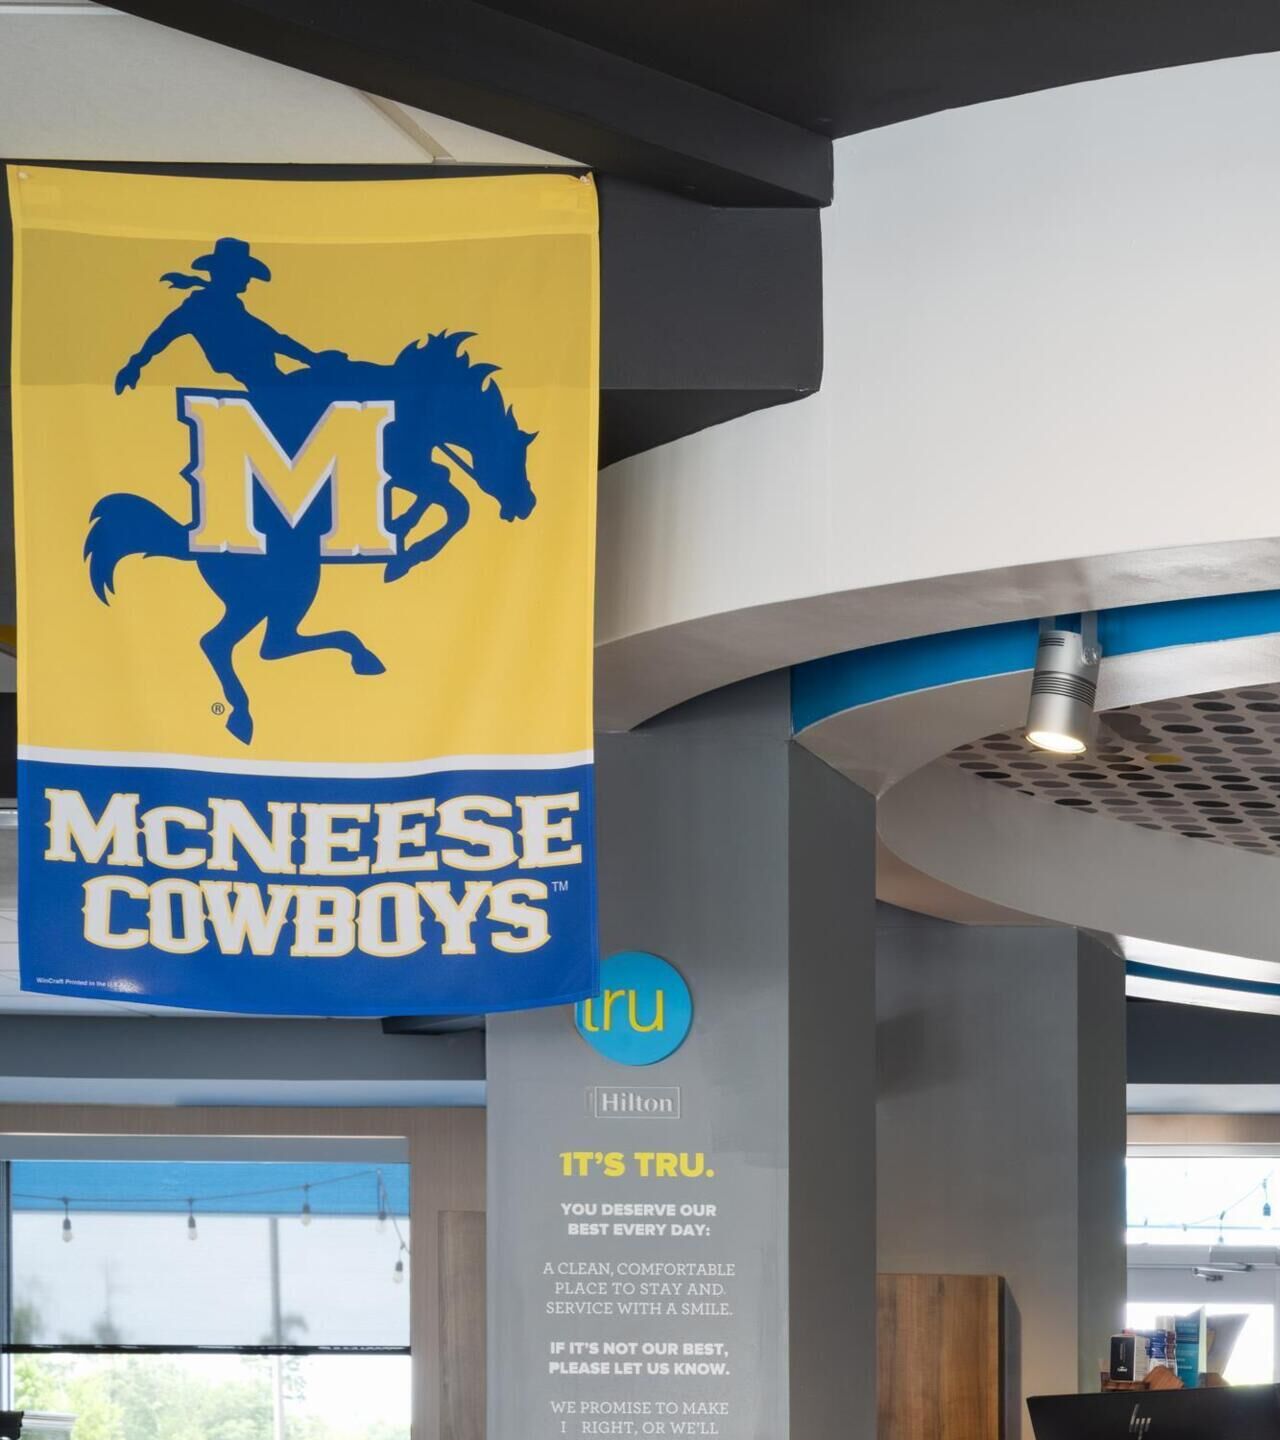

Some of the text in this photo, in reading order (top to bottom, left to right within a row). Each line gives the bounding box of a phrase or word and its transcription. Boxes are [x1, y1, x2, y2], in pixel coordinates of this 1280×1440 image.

[184, 394, 397, 557] M
[81, 874, 552, 958] COWBOYS
[601, 1092, 673, 1112] Hilton
[559, 1152, 715, 1177] IT'S TRU.
[560, 1203, 717, 1217] YOU DESERVE OUR
[567, 1223, 711, 1237] BEST EVERY DAY:
[543, 1262, 736, 1277] A CLEAN, COMFORTABLE
[554, 1283, 607, 1295] PLACE
[612, 1283, 636, 1295] TO
[640, 1283, 682, 1295] STAY
[546, 1302, 733, 1316] SERVICE WITH A SMILE.
[550, 1342, 729, 1358] IF IT'S NOT OUR BEST,
[549, 1362, 731, 1376] PLEASE LET US KNOW.
[550, 1401, 729, 1415] WE PROMISE TO MAKE
[582, 1421, 638, 1436] RIGHT,
[642, 1421, 666, 1434] OR
[669, 1421, 719, 1435] WE'LL
